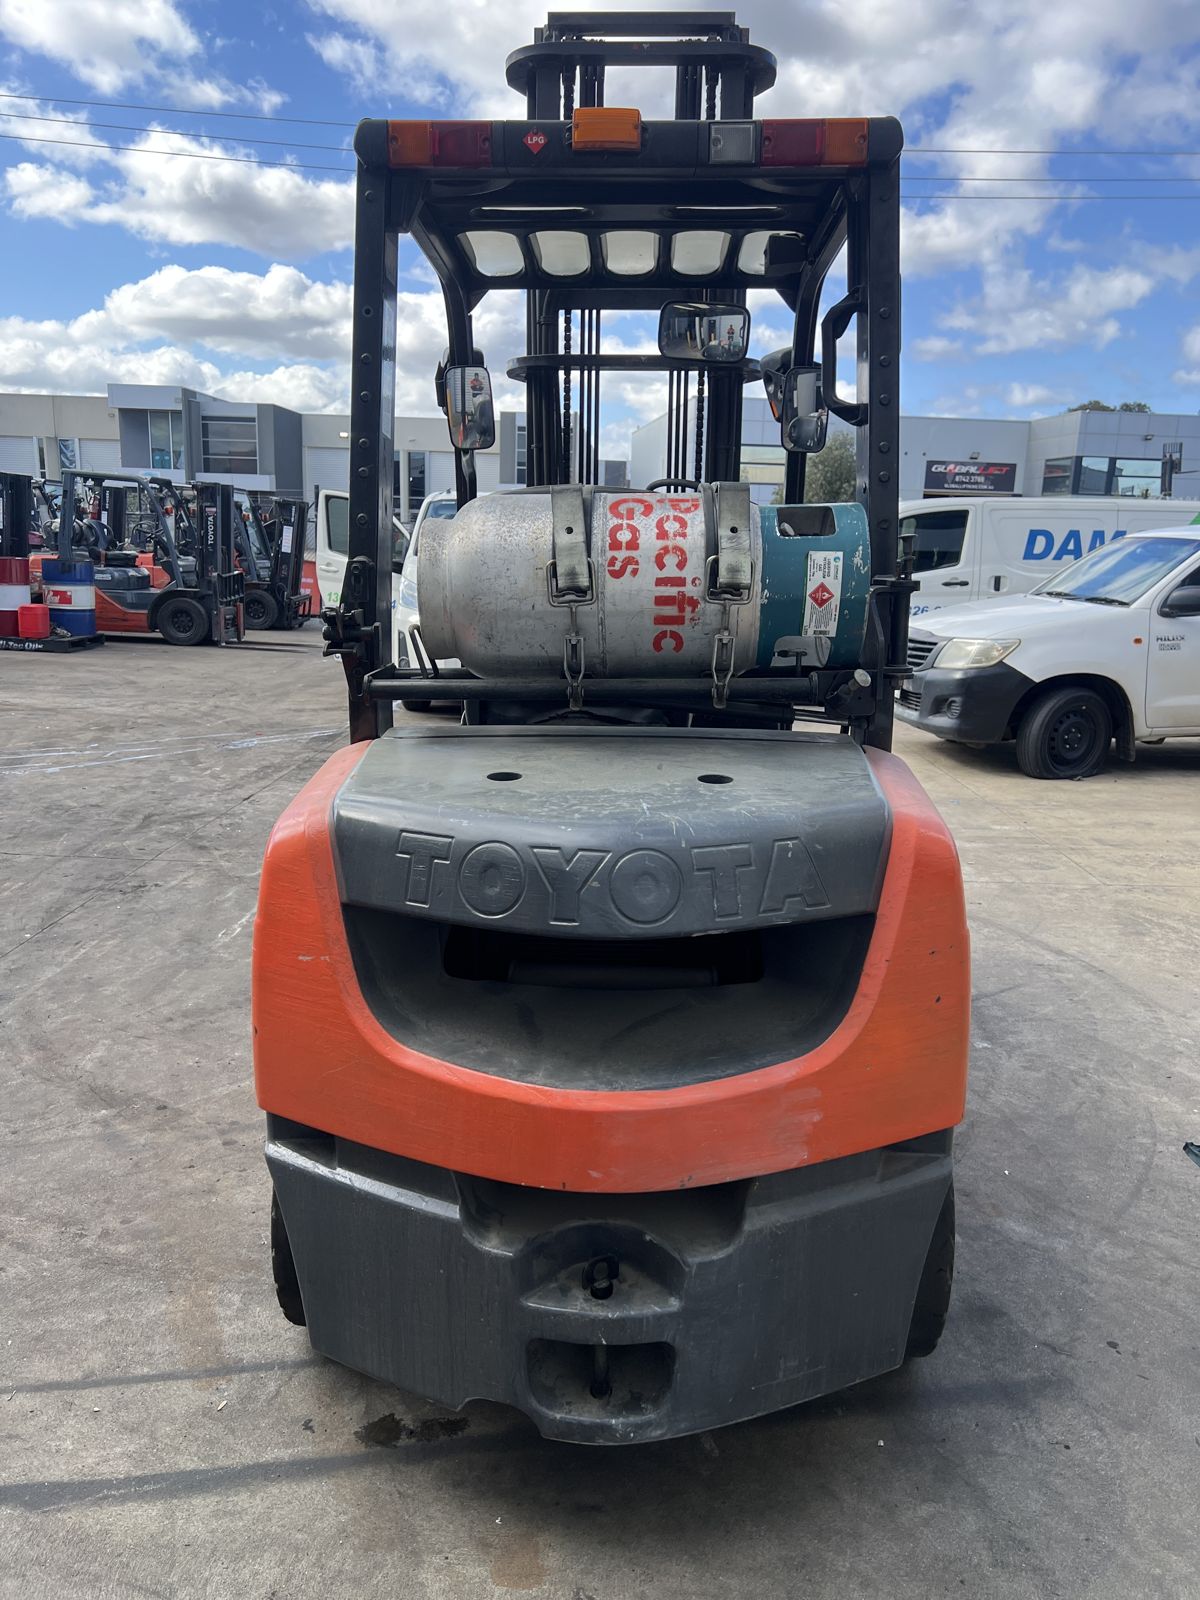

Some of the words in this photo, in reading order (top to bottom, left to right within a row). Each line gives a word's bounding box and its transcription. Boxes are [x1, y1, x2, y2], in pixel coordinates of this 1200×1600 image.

[527, 136, 545, 144] LPG
[607, 498, 654, 579] Gas
[652, 497, 702, 654] Pacific
[395, 830, 832, 927] TOYOTA
